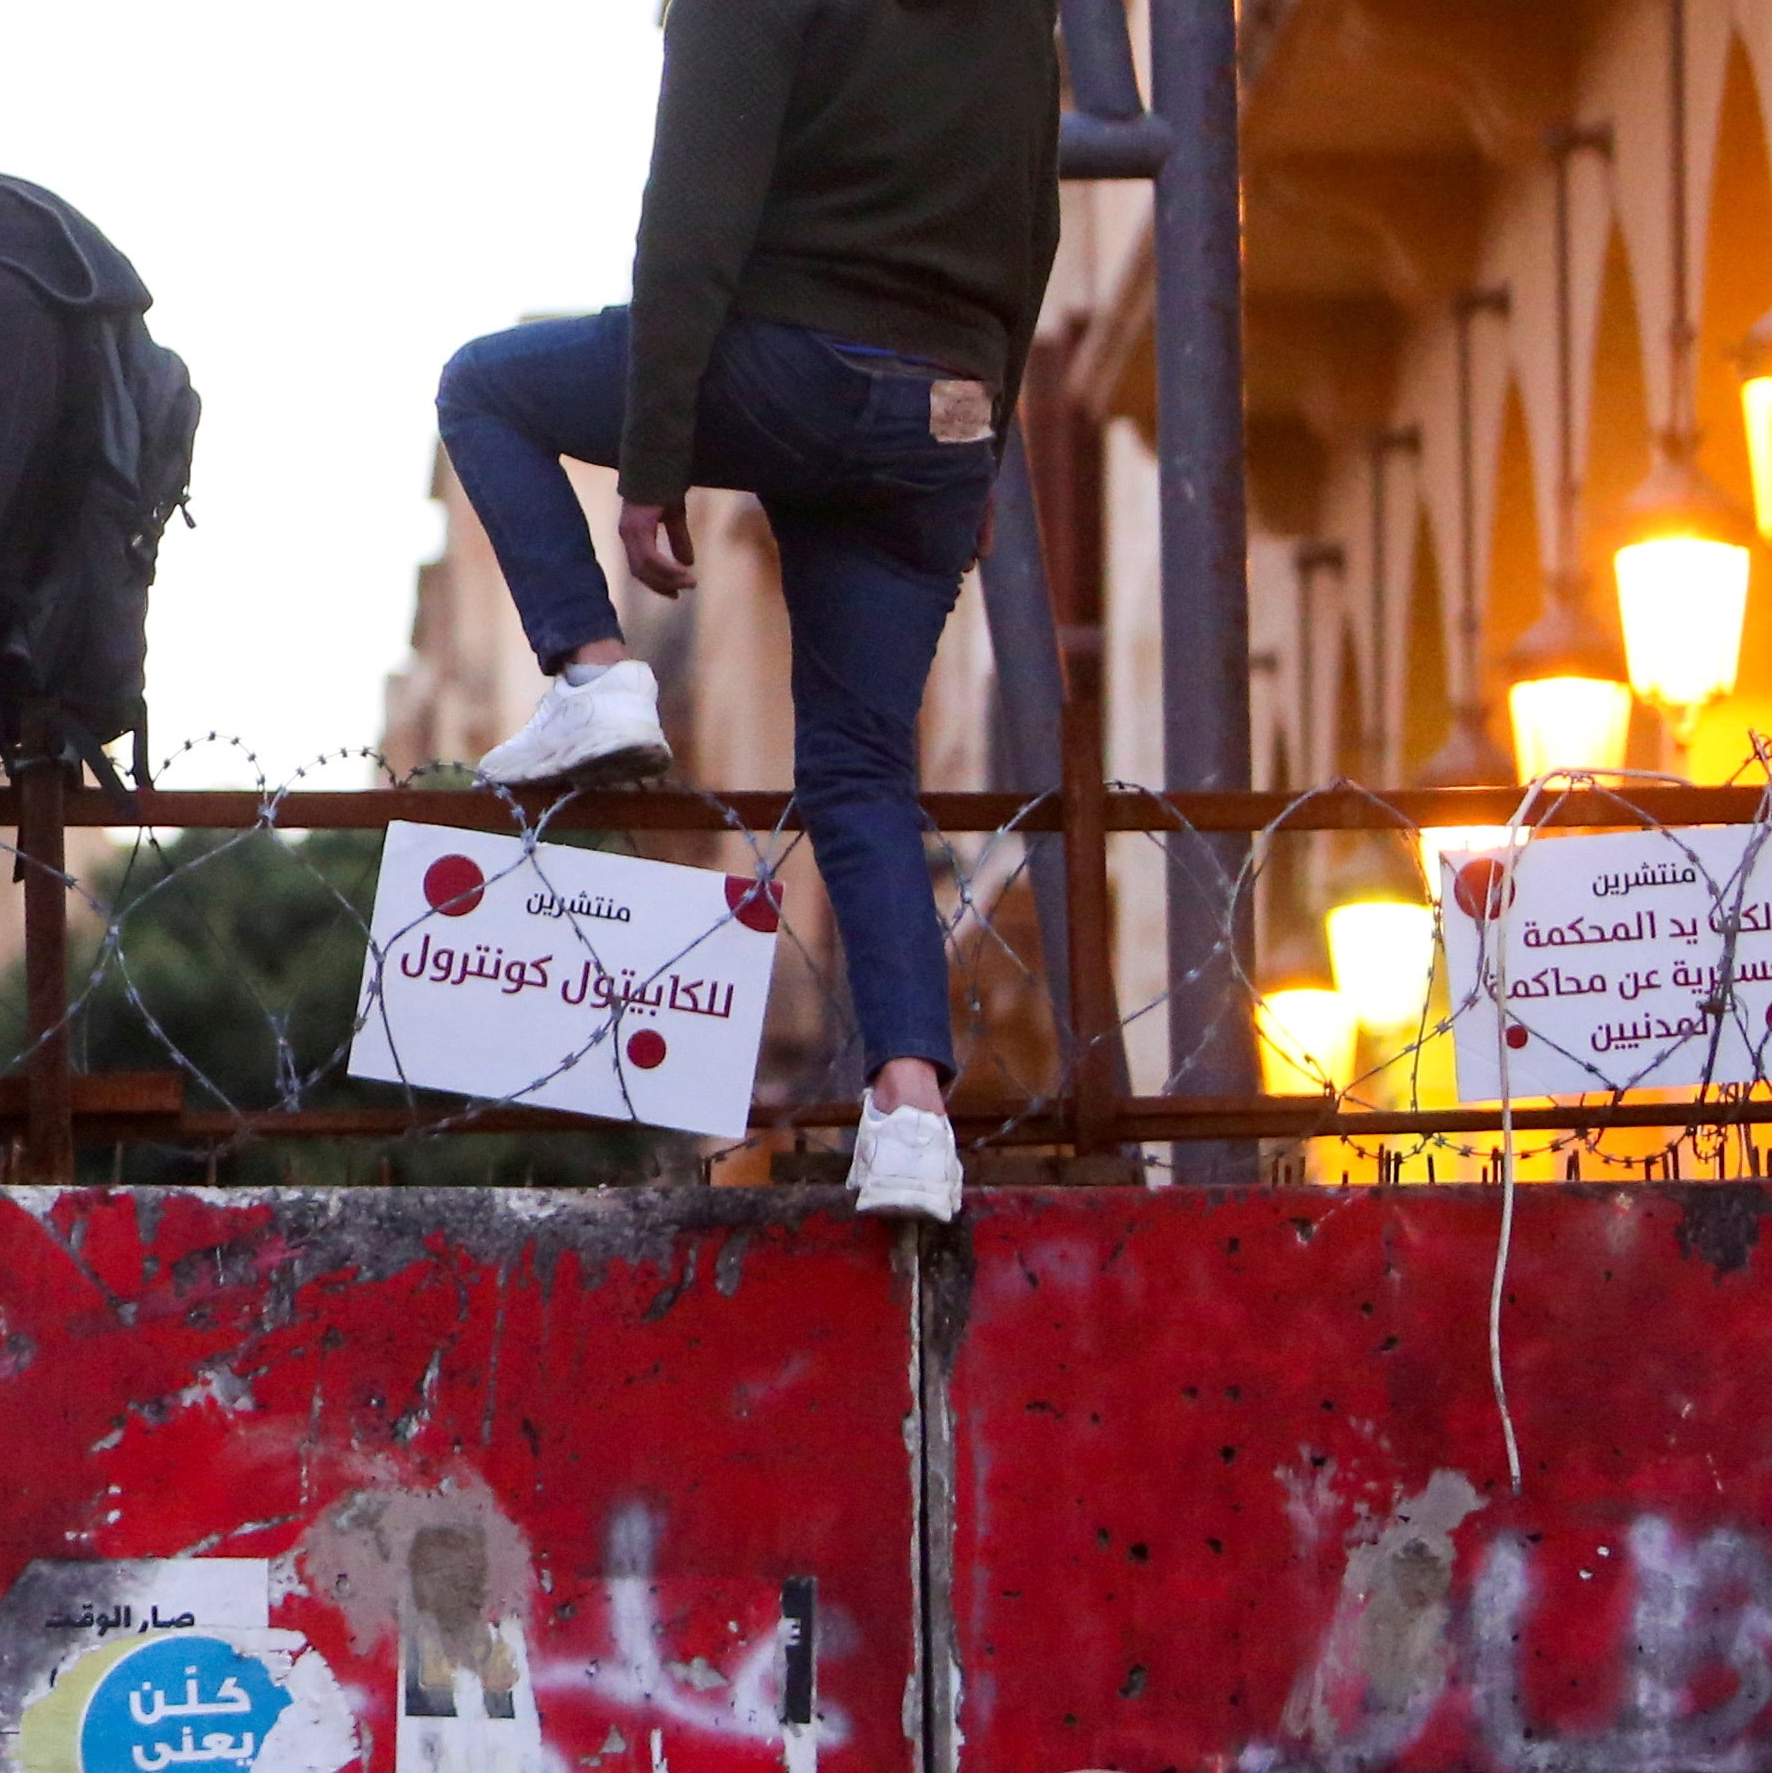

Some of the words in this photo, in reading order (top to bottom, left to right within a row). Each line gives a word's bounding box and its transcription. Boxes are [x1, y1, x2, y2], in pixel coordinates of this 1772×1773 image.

[1592, 862, 1696, 897] منتشرين
[526, 890, 631, 923] منتشرين
[1523, 910, 1656, 948] المحكمة
[1669, 917, 1698, 945] يد
[400, 934, 553, 994] كونترول
[561, 960, 734, 1017] للكابيتول
[1618, 969, 1661, 1000] عن
[1591, 1009, 1708, 1052] لمدنيين
[45, 1603, 131, 1637] الوقت
[138, 1605, 195, 1633] صار
